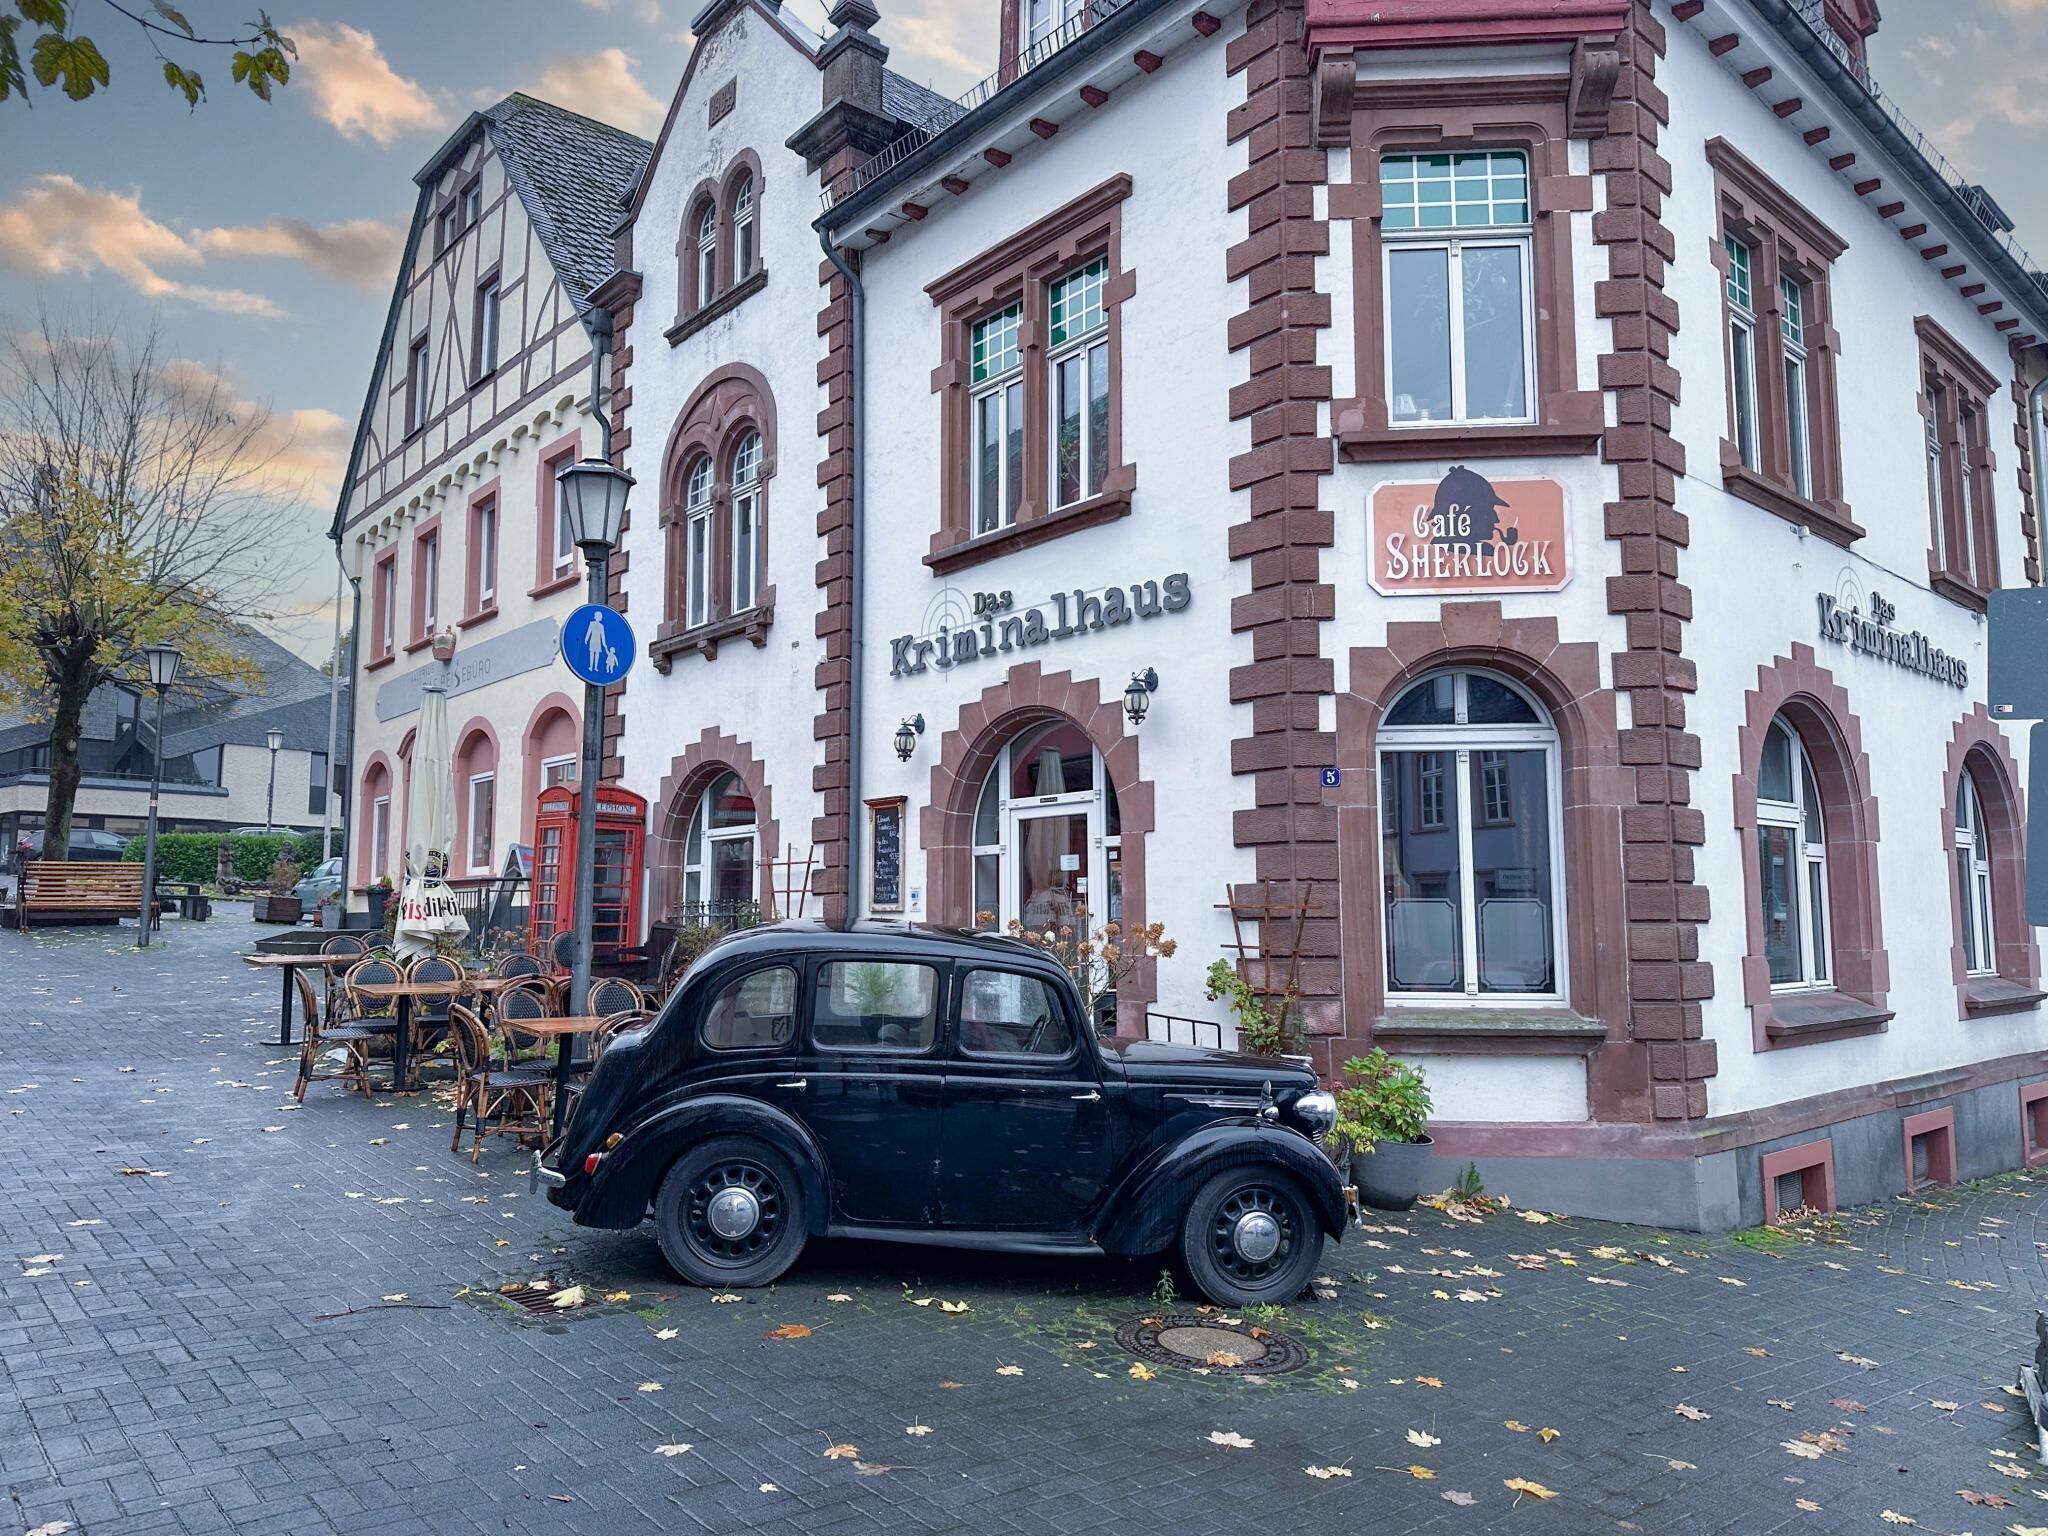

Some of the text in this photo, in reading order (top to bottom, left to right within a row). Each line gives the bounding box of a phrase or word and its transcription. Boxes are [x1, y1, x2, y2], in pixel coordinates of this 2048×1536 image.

[1412, 503, 1472, 538] Café
[1385, 532, 1552, 580] SHERLOCK
[973, 590, 1013, 615] Das
[1870, 590, 1896, 621] Das
[890, 573, 1192, 677] Kriminalhaus
[1817, 592, 1969, 689] Kriminalhaus
[1326, 770, 1336, 784] 5
[595, 802, 635, 814] LEPHONE
